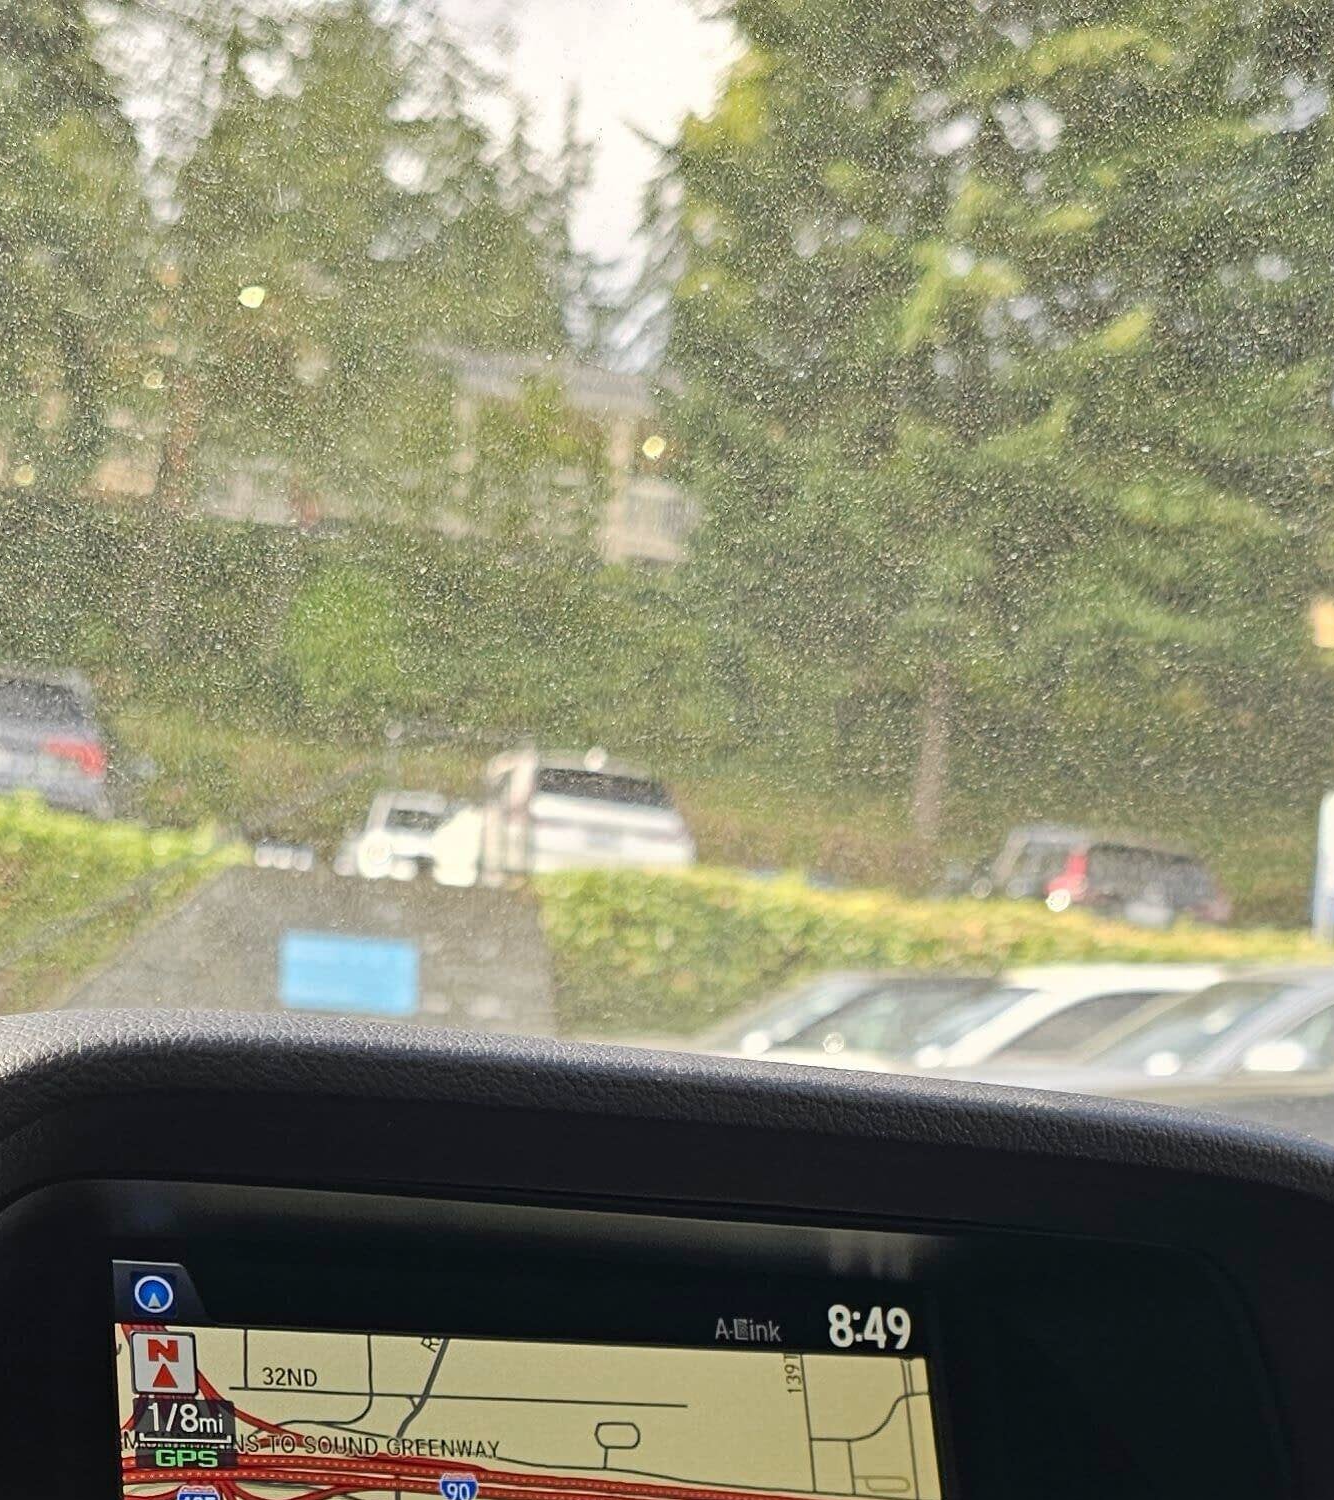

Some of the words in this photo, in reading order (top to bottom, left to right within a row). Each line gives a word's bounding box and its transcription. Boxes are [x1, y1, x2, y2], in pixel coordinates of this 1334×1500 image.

[828, 1304, 911, 1349] 8:49
[147, 1339, 179, 1363] N
[261, 1366, 318, 1388] 32ND
[155, 1449, 219, 1468] GPS
[267, 1437, 296, 1454] TO
[304, 1436, 378, 1455] SOUND
[386, 1438, 501, 1459] GREENWAY
